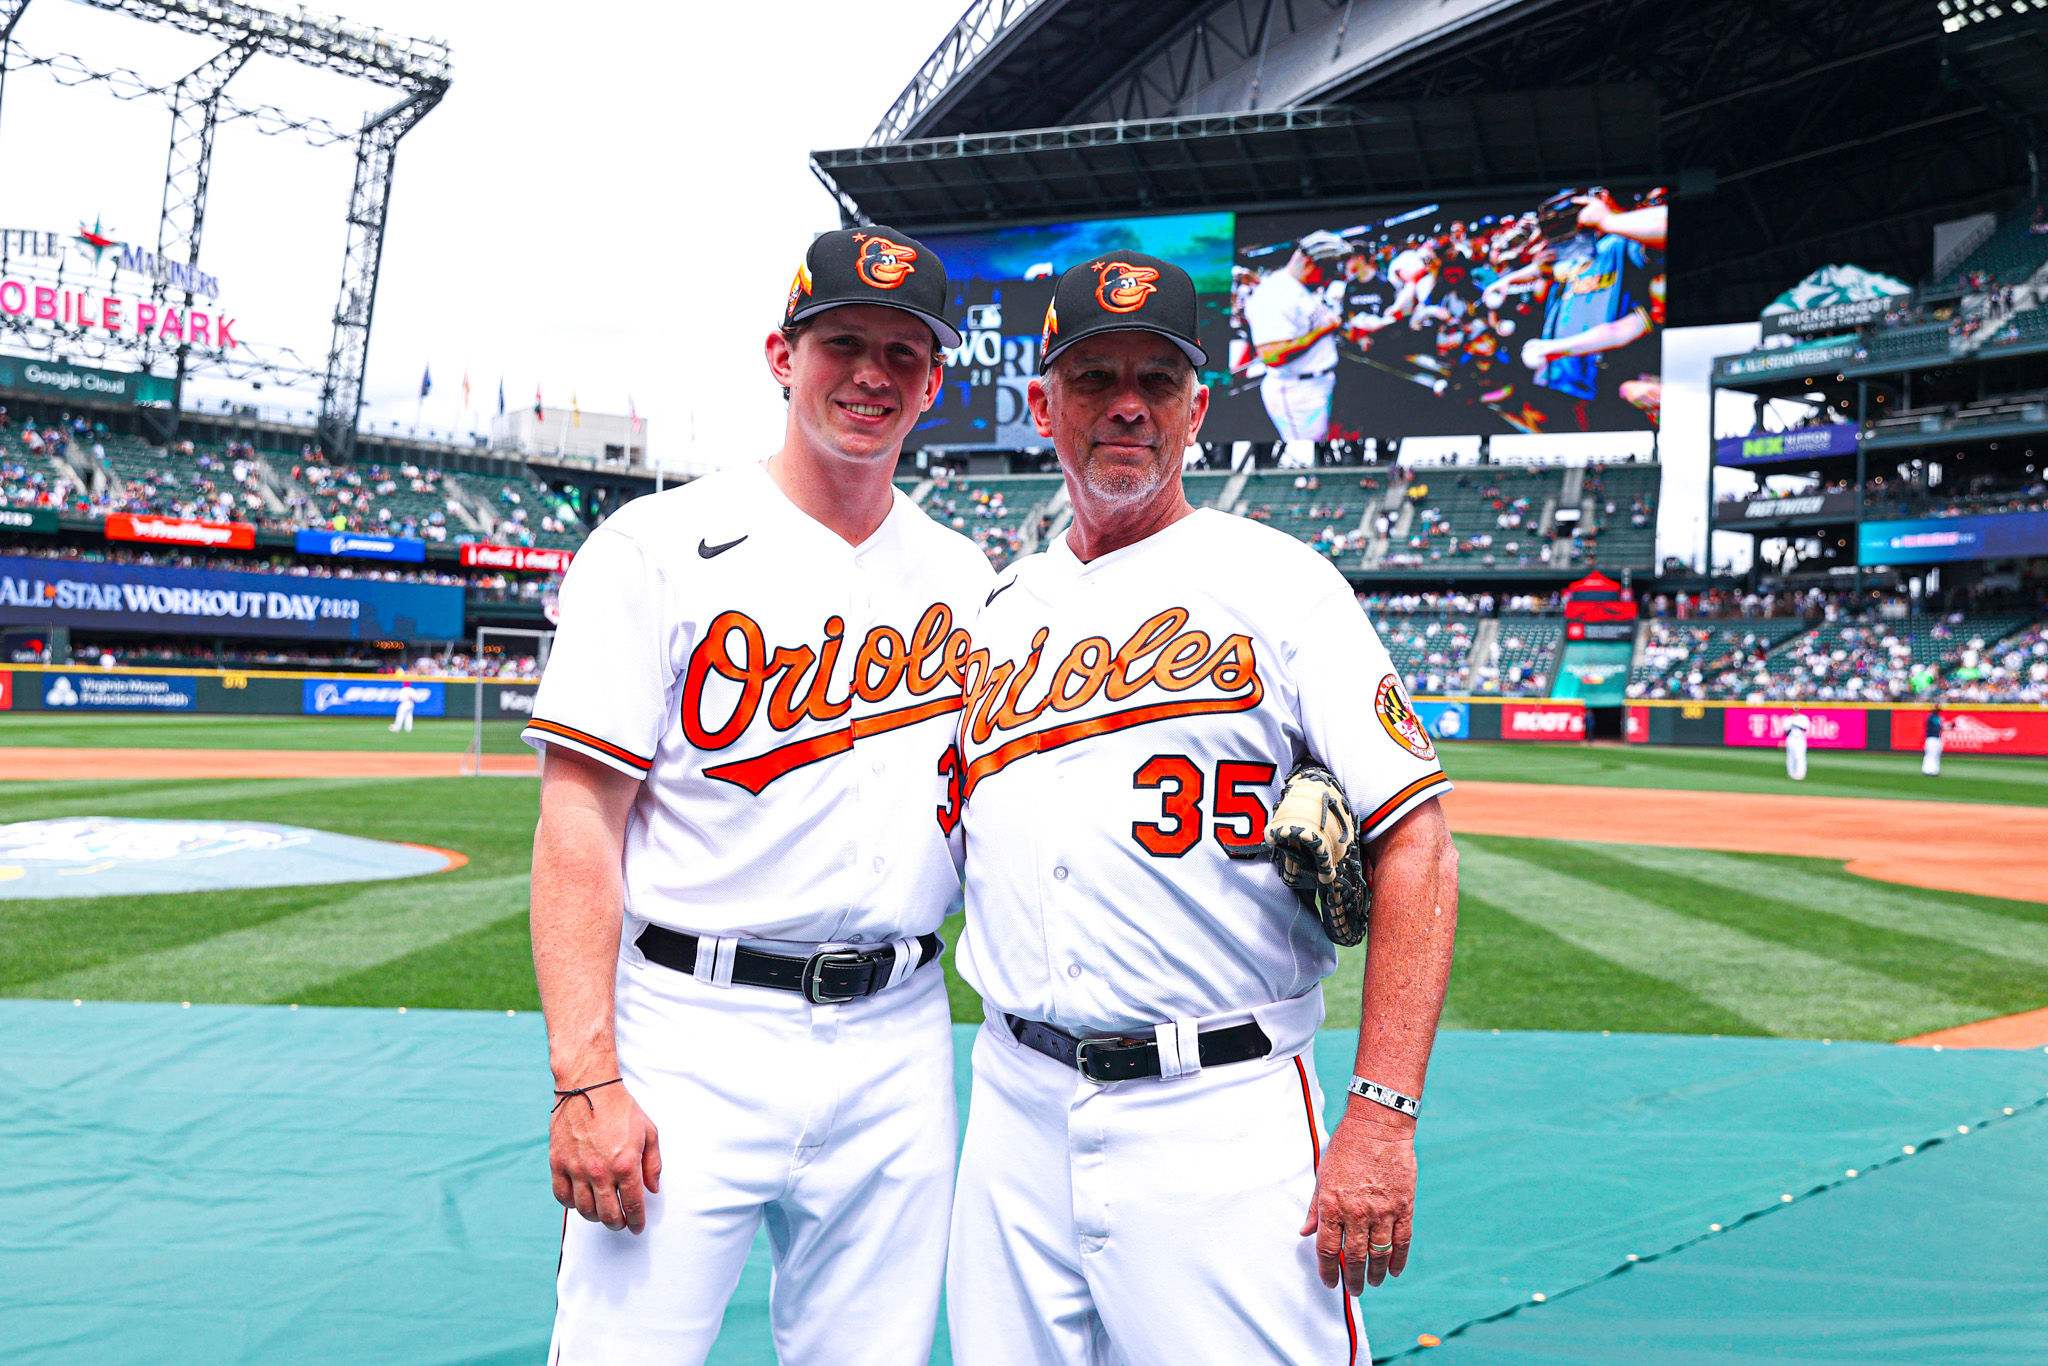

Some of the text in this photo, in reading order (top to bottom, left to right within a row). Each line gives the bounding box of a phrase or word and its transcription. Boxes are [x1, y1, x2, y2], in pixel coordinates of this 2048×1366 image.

[138, 303, 237, 349] PARK
[1777, 297, 1893, 328] MUCKLESHOOT
[24, 364, 126, 394] Google Cloud
[1, 576, 360, 621] ALL STAR WORKOUT DAY 2023
[1132, 755, 1278, 860] 35
